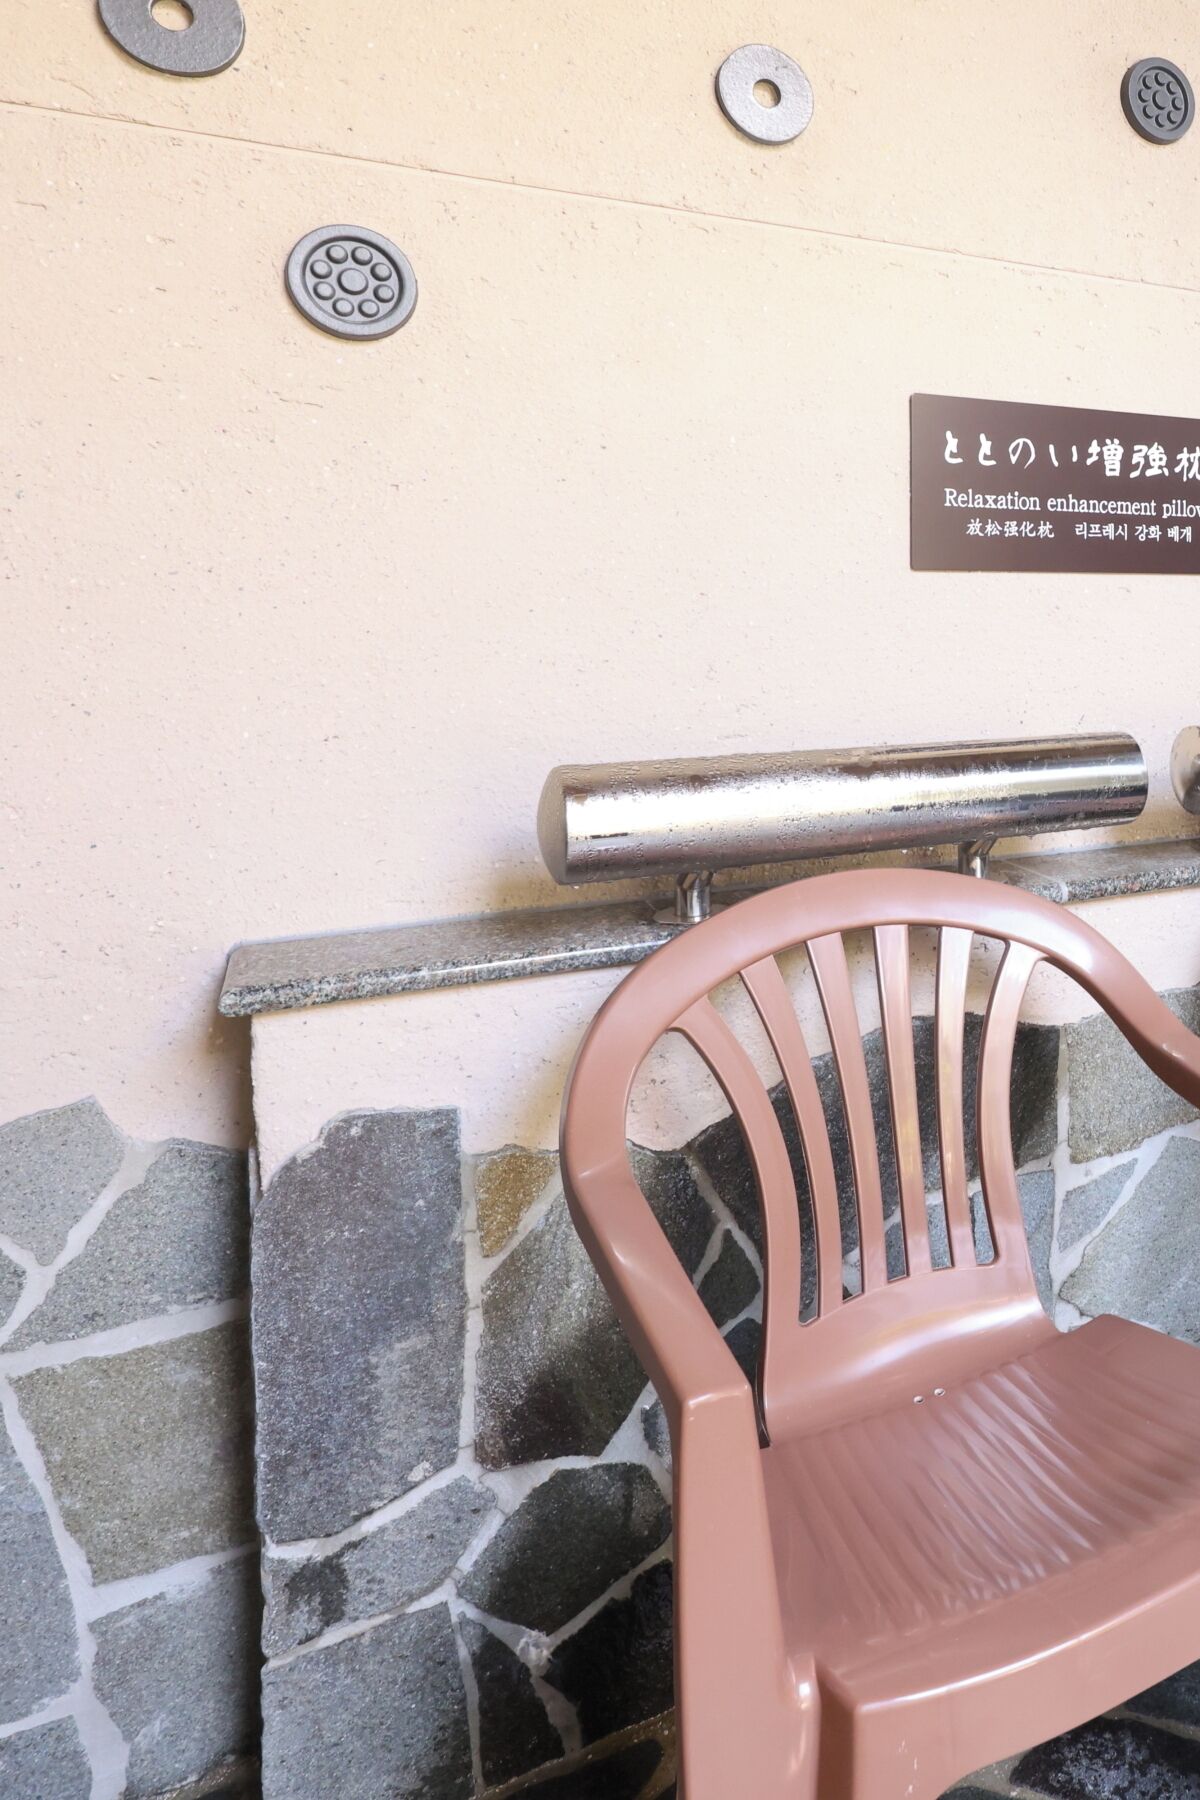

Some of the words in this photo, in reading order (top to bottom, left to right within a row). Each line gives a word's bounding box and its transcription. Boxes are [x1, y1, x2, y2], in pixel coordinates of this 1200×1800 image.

[943, 487, 1041, 511] Relaxation
[1047, 493, 1157, 517] enhancement
[966, 517, 1055, 539] 放松强化枕
[1074, 521, 1128, 541] 리프레시
[1134, 523, 1162, 542] 강화
[1167, 525, 1192, 543] 베개
